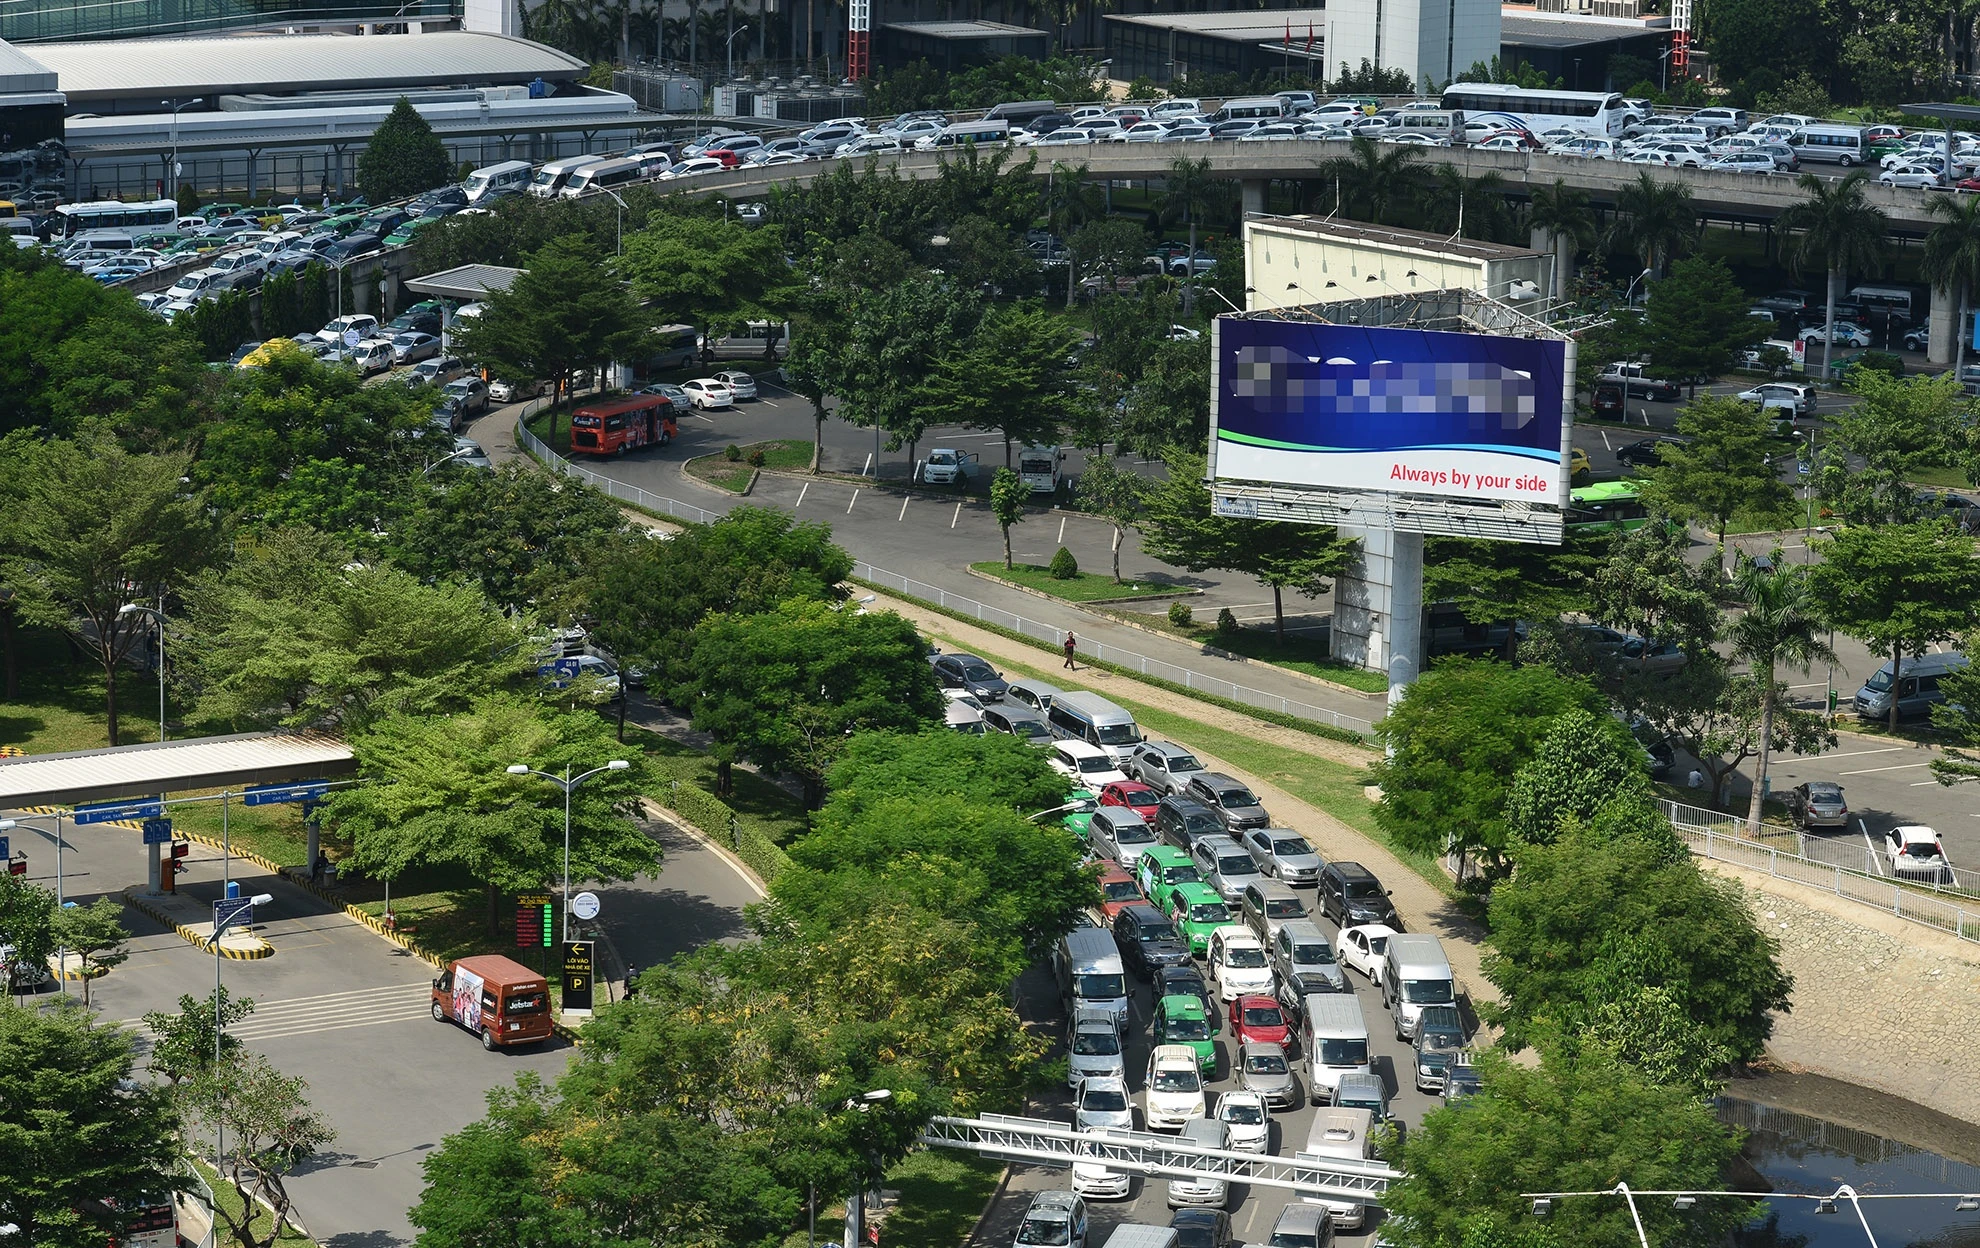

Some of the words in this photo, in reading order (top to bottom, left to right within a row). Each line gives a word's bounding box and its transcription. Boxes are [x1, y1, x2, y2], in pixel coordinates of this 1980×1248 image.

[1390, 464, 1447, 485] Always
[1451, 468, 1471, 489] by
[1475, 474, 1511, 490] your
[1515, 474, 1547, 492] side
[574, 978, 582, 988] P
[510, 1000, 533, 1009] Jetstar
